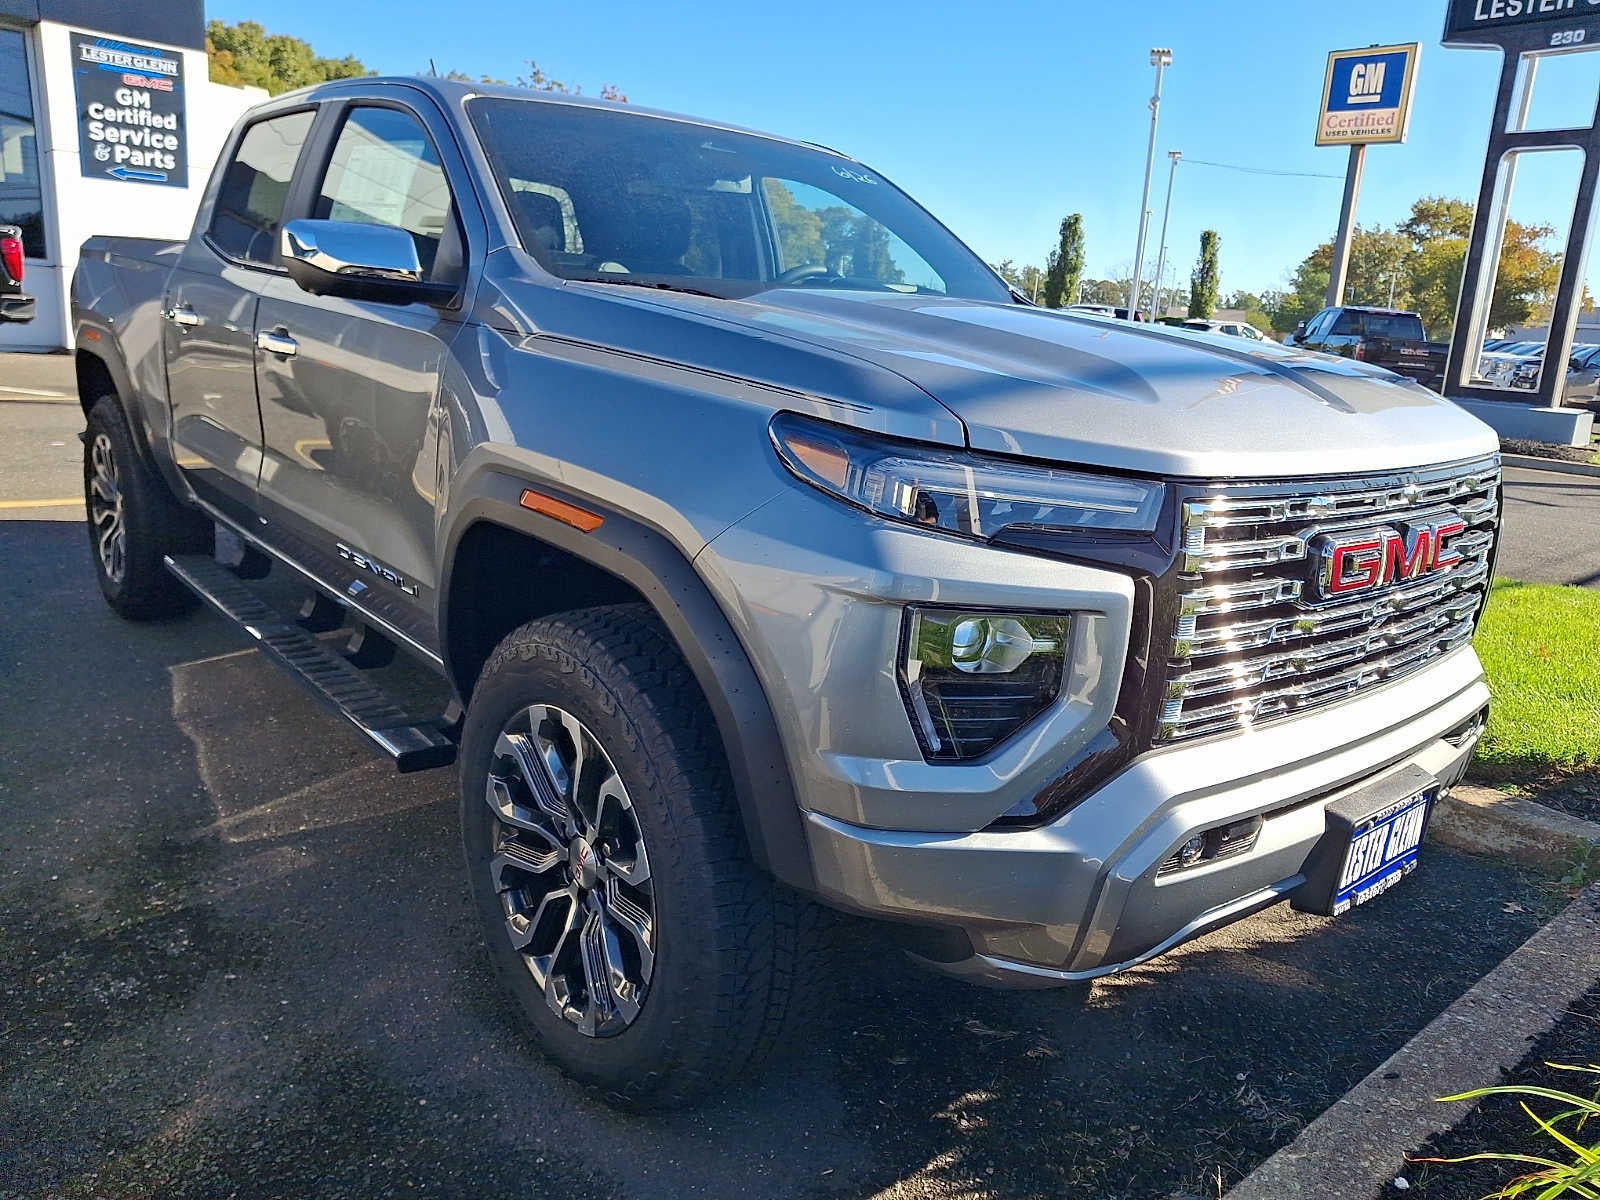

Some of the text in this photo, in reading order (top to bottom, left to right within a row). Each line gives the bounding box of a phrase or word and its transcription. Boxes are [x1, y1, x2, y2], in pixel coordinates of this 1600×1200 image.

[1550, 29, 1586, 46] 230
[81, 46, 132, 66] LESTER
[133, 57, 178, 74] GLENN
[123, 73, 174, 92] GMC
[1349, 62, 1386, 96] GM
[115, 88, 151, 109] GM
[88, 103, 177, 130] Certified
[1326, 111, 1396, 129] Certified
[88, 121, 178, 150] Service
[1350, 127, 1392, 136] VEHICLES
[94, 143, 176, 169] & Parts
[336, 542, 419, 597] DENALI
[1329, 520, 1465, 594] GMC
[1340, 822, 1391, 889] LESTER
[1385, 803, 1426, 862] GLENN
[575, 846, 589, 880] GMC
